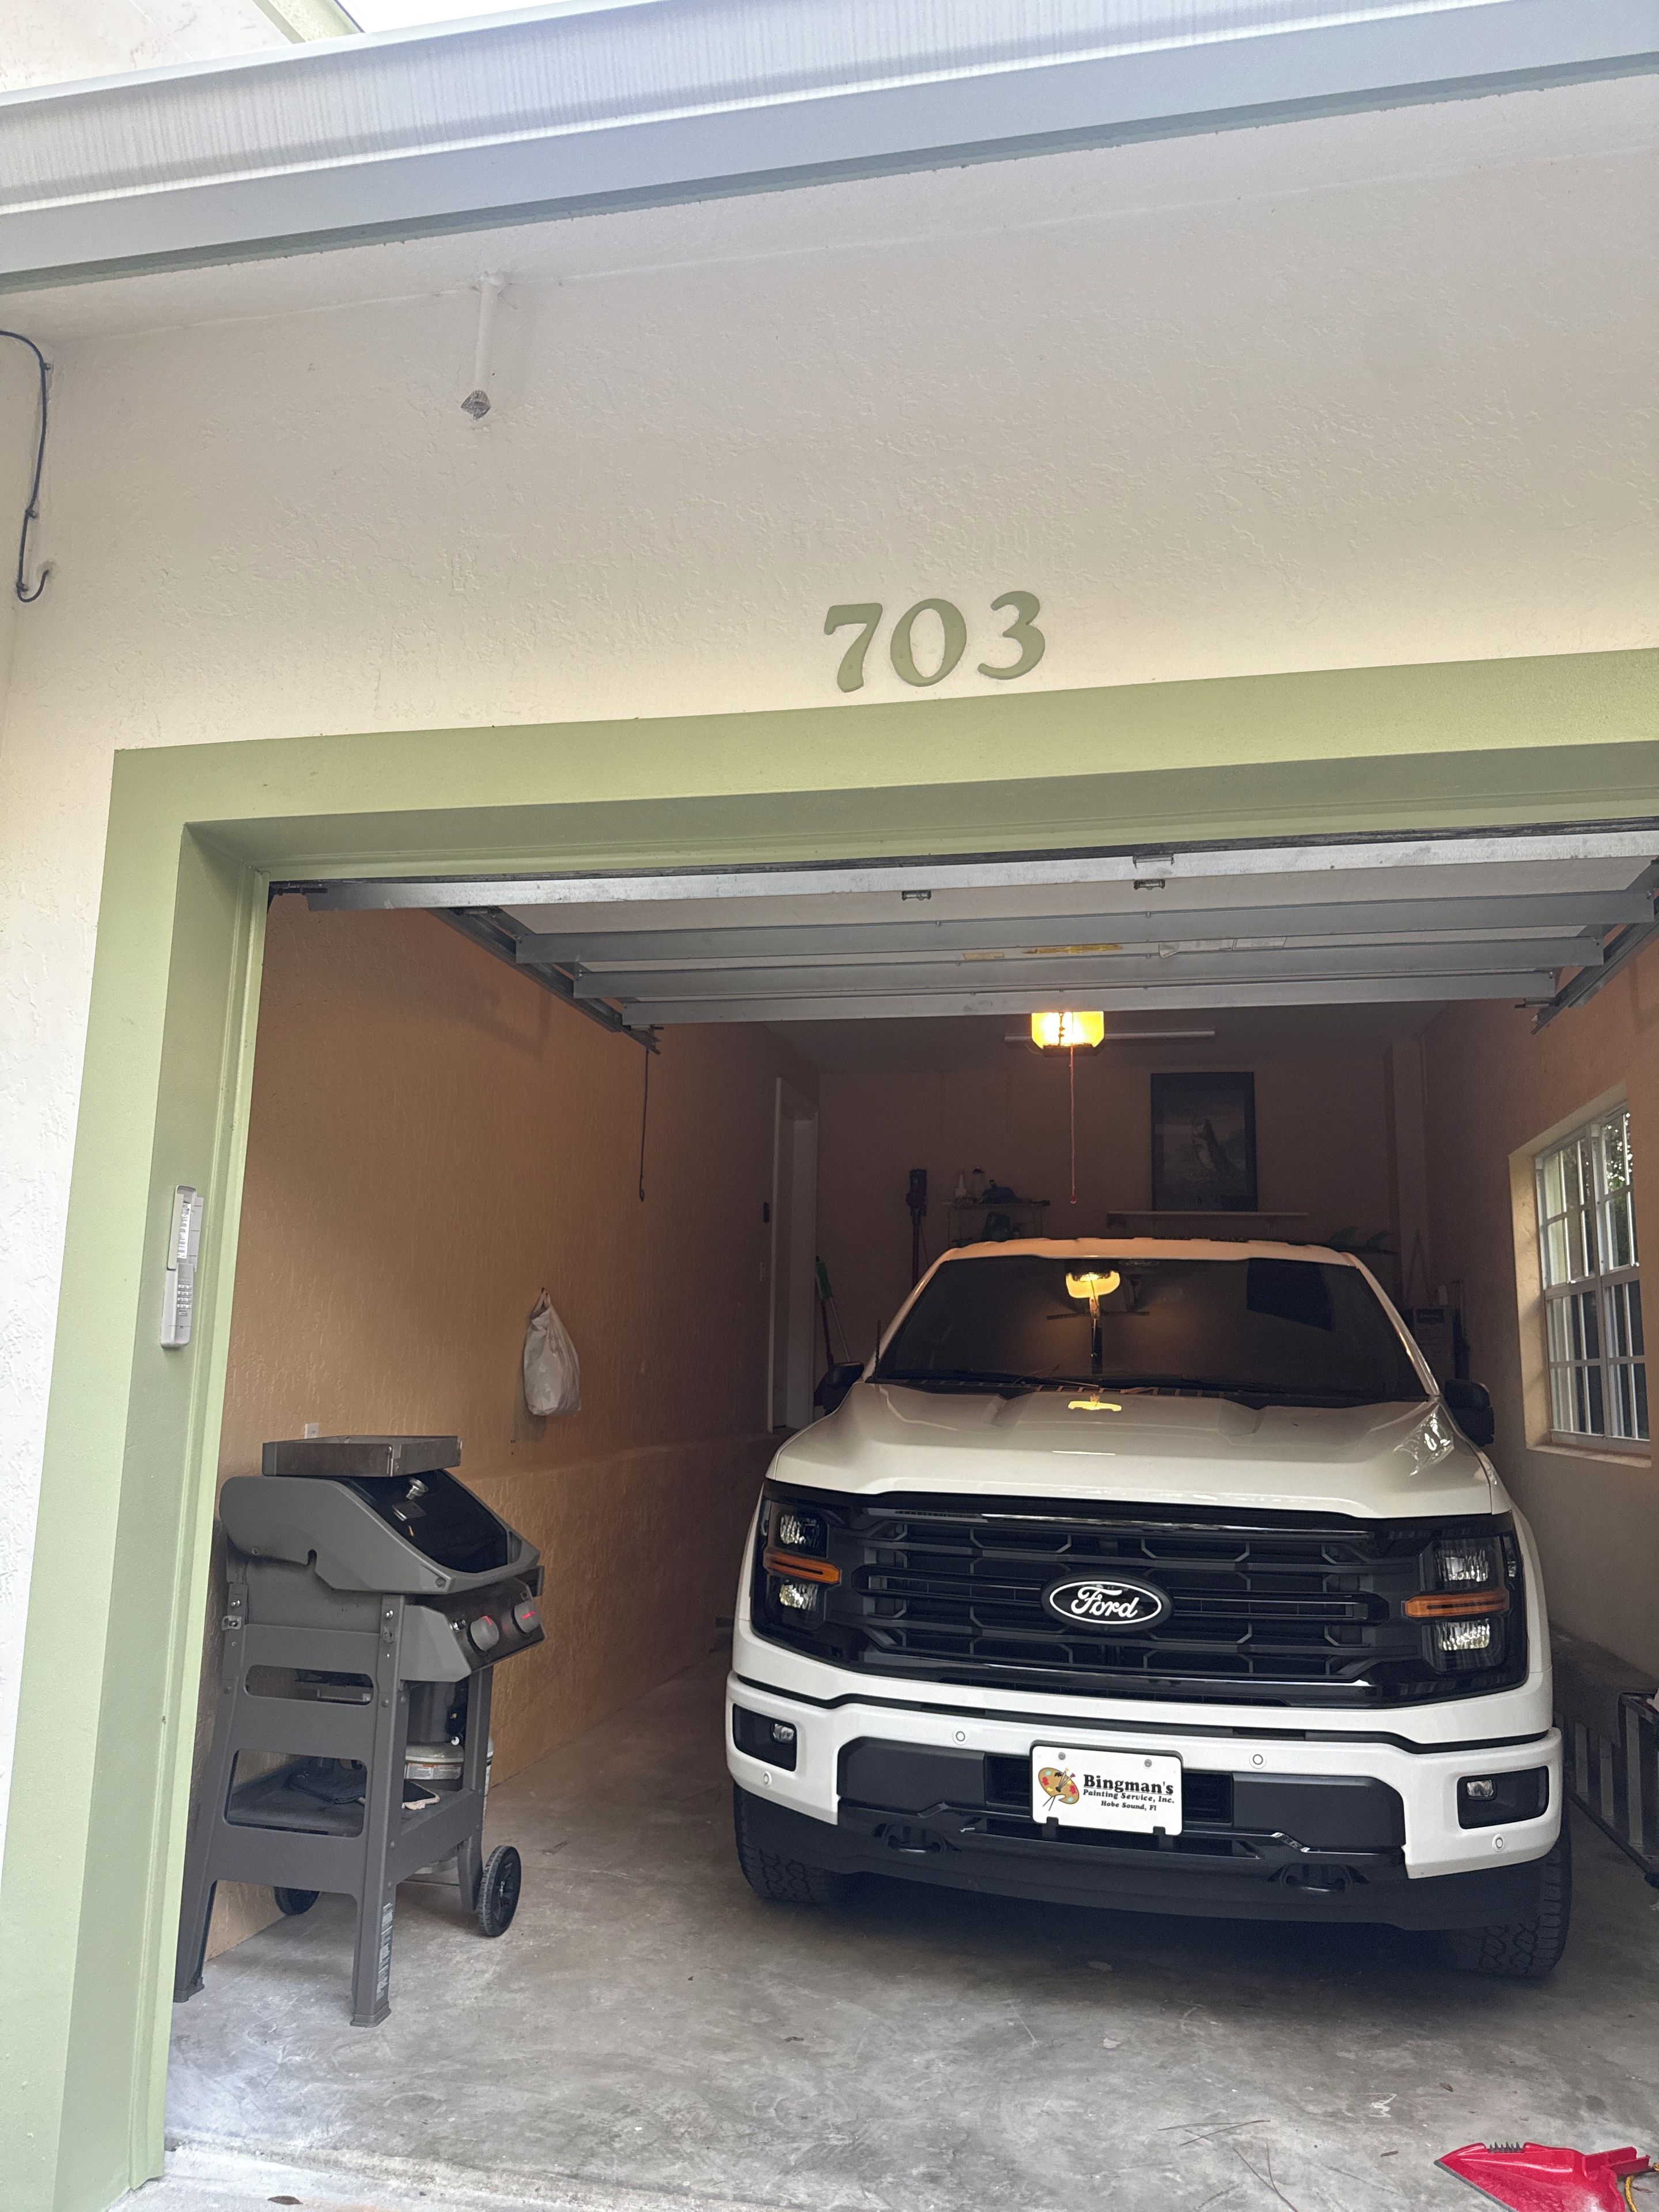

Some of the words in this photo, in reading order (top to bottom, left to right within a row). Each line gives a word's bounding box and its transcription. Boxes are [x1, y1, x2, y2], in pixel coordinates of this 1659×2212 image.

[824, 590, 1046, 693] 703
[1071, 1586, 1140, 1618] Ford
[1084, 1774, 1174, 1794] Bingman's
[1083, 1789, 1118, 1800] Painting
[1121, 1793, 1156, 1802] Service,
[1158, 1796, 1175, 1804] Inc.
[1122, 1802, 1146, 1811] Sound,
